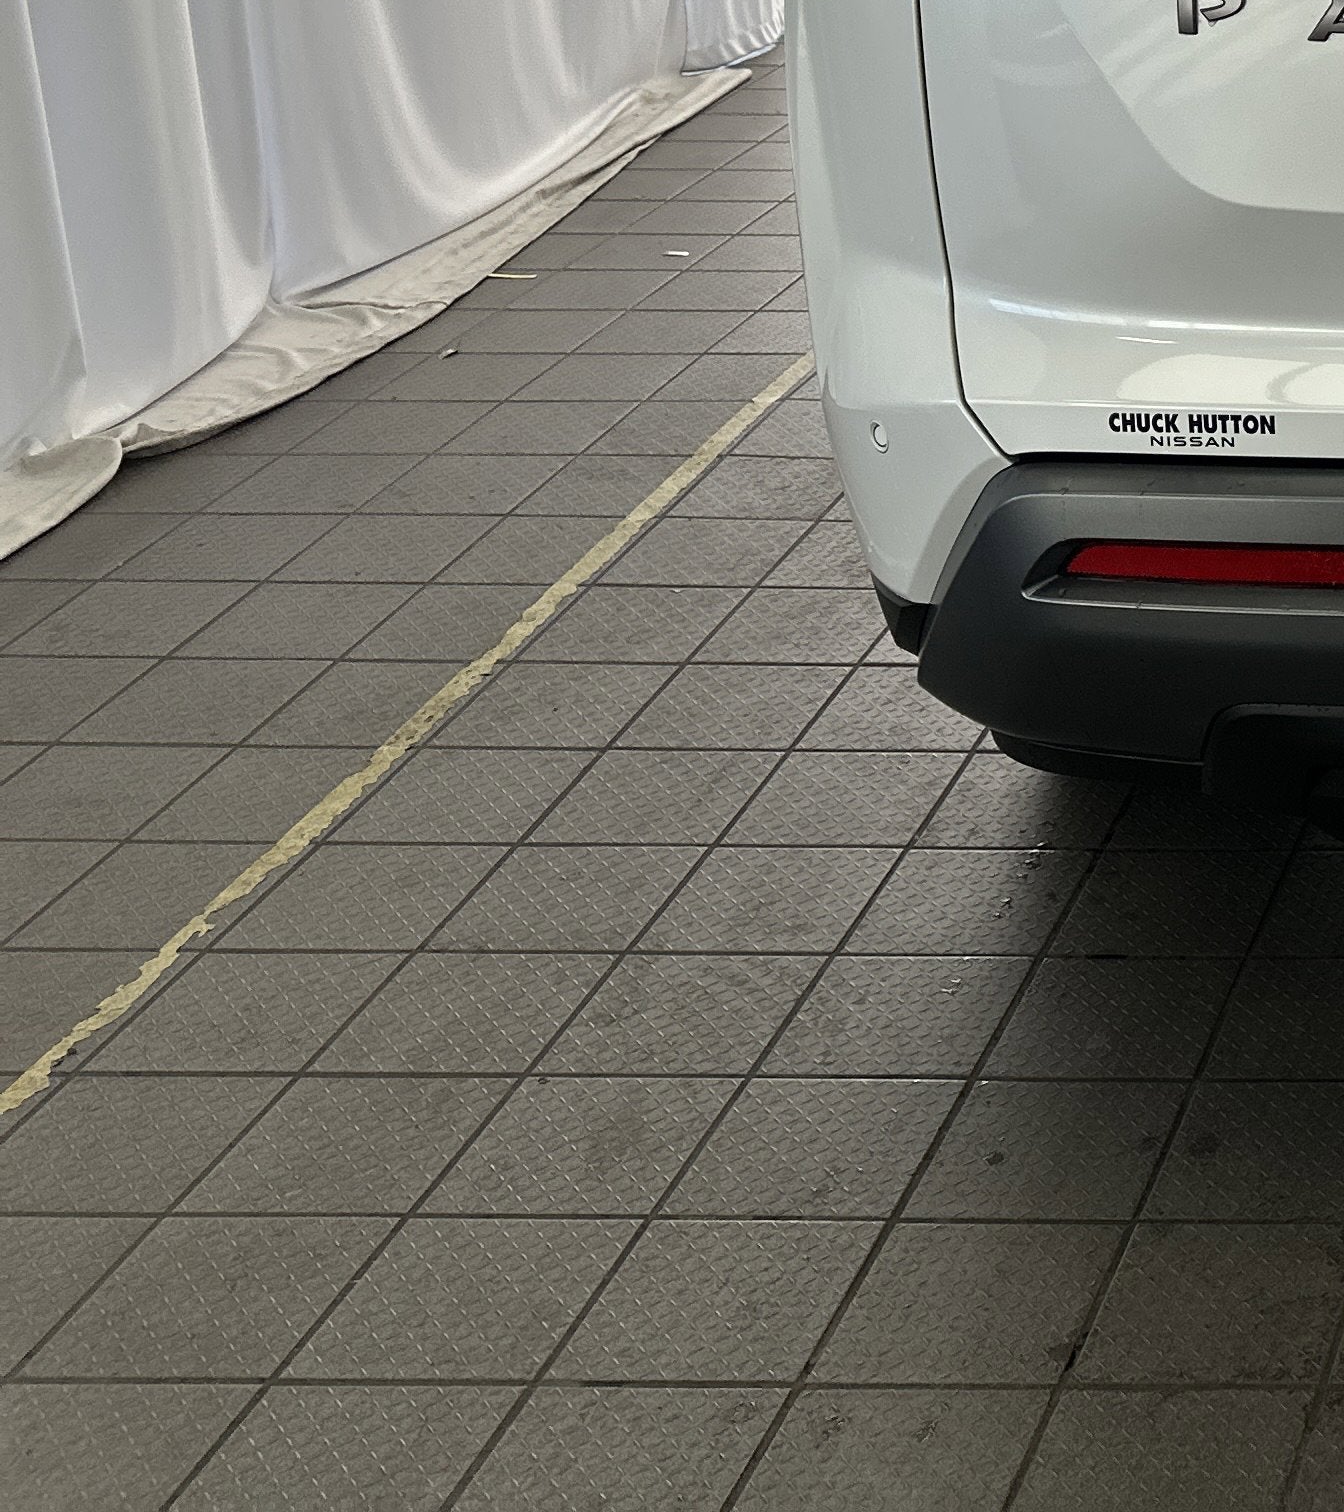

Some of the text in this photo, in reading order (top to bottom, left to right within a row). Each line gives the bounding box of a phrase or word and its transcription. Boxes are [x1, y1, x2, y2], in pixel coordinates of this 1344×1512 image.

[1108, 412, 1276, 434] CHUCK HUTTON
[1149, 435, 1235, 448] NISSAN
